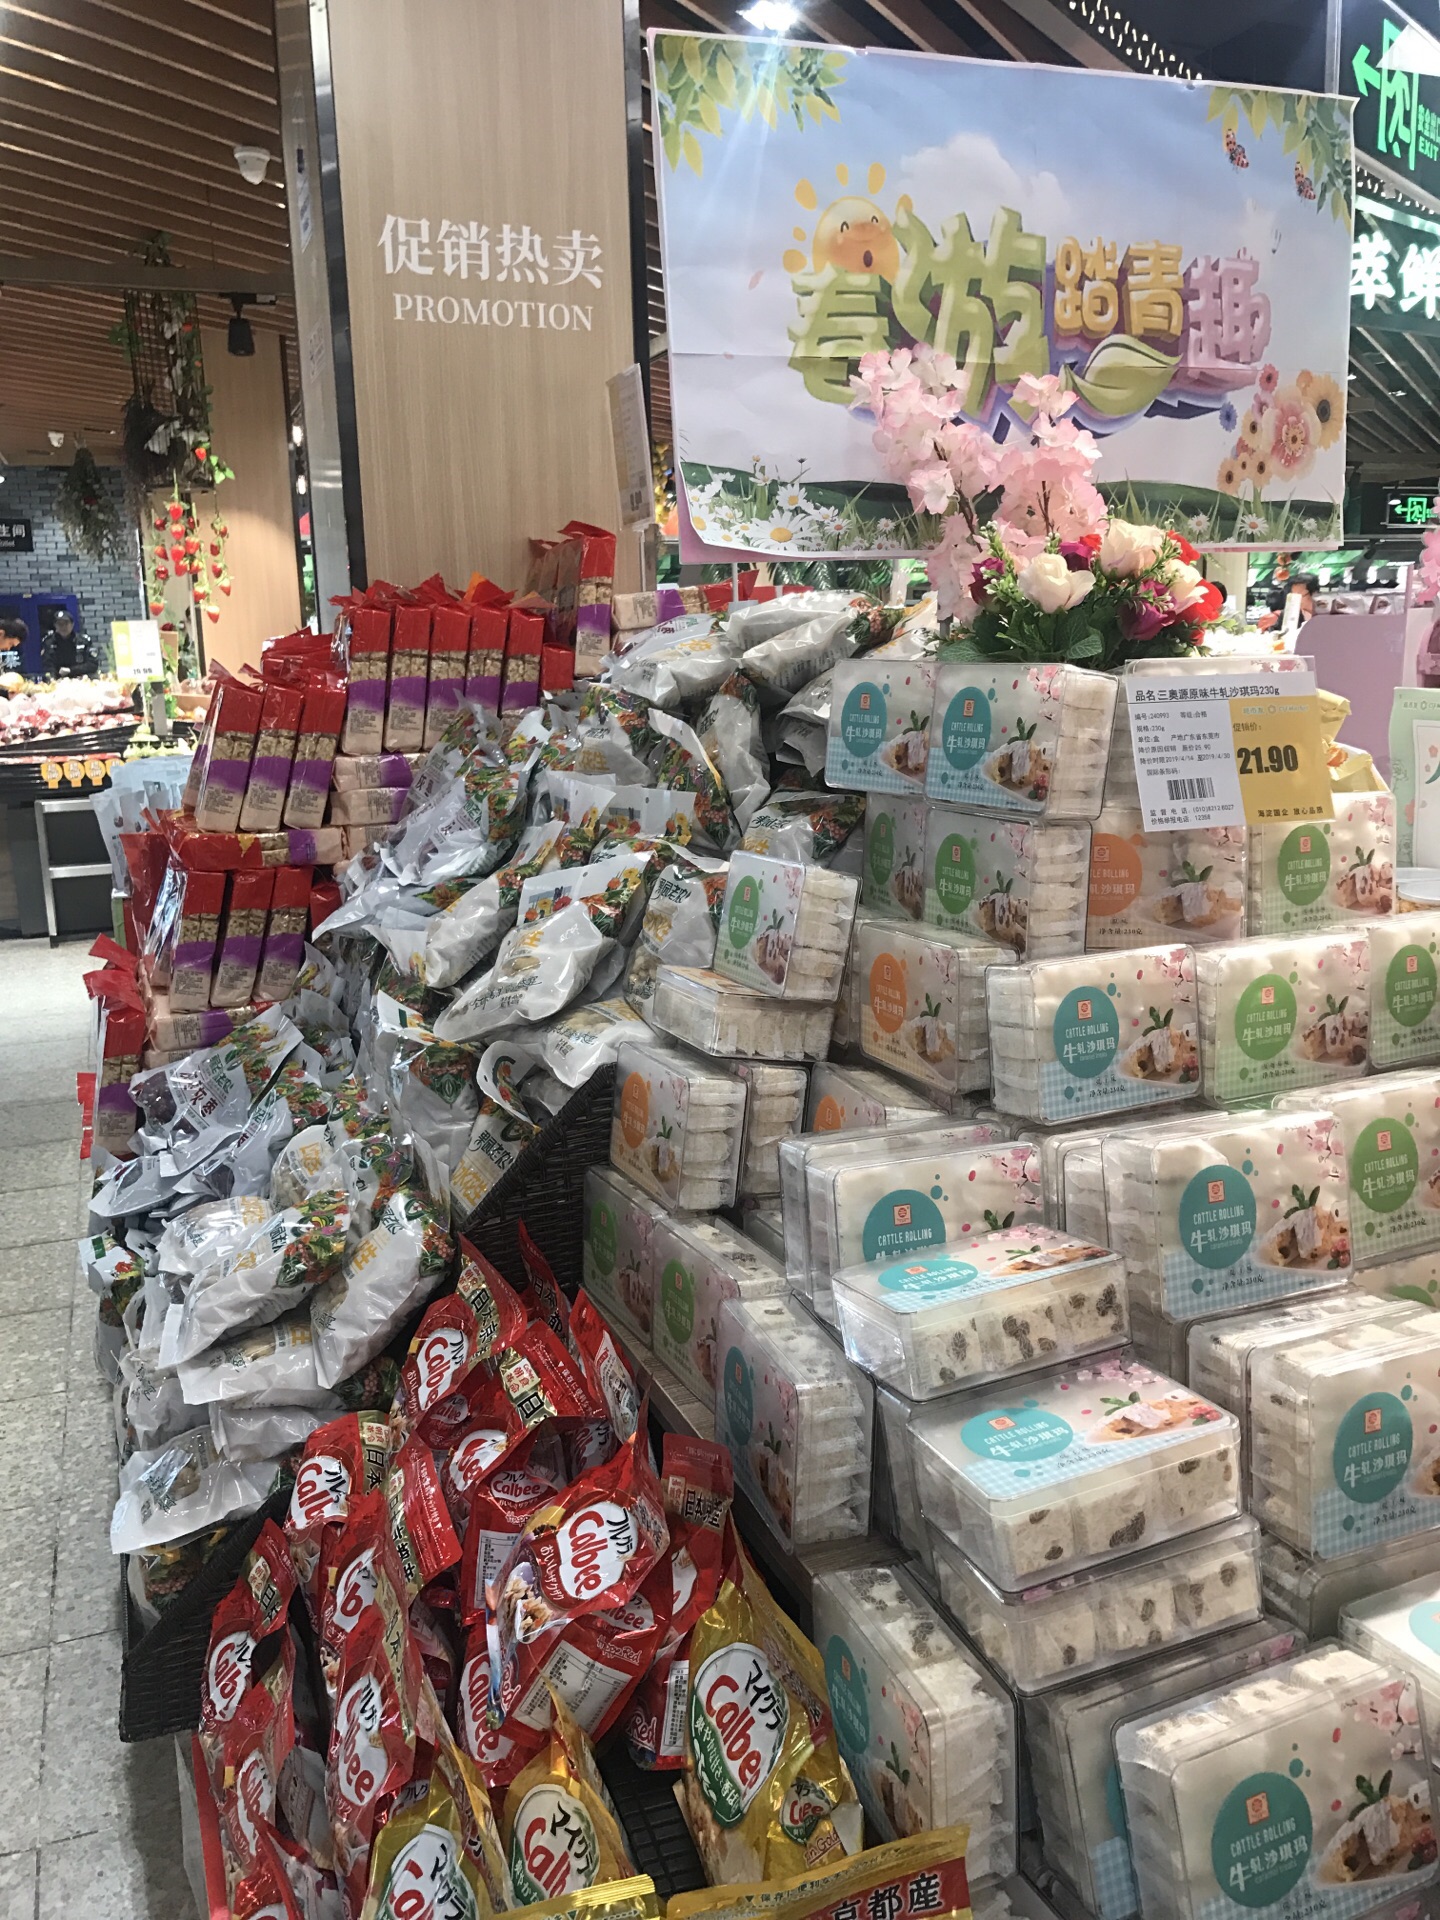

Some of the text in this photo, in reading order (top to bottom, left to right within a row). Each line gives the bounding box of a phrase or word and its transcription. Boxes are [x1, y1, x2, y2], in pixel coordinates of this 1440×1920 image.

[1419, 136, 1439, 161] EXIT
[377, 214, 604, 289] 促销热卖
[393, 292, 593, 331] PROMOTION
[1237, 744, 1299, 775] 21.90
[1065, 1022, 1109, 1039] CATTLE ROLLING
[1063, 1037, 1115, 1064] 牛轧沙琪玛
[1193, 1205, 1244, 1225] CATTLE ROLLING
[878, 1228, 932, 1246] CATTLE ROLLING
[1190, 1220, 1252, 1253] 牛轧沙琪玛
[984, 1421, 1049, 1445] CATTLE ROLLING
[1348, 1432, 1400, 1458] CATTLE ROLLING
[1344, 1449, 1407, 1488] 牛轧沙琪玛
[493, 1480, 541, 1498] Calbee
[607, 1507, 633, 1555] フルグラ
[568, 1510, 605, 1597] Calbee
[744, 1659, 784, 1731] マイグラ
[550, 1801, 594, 1875] マイグラ
[1230, 1817, 1296, 1858] CATTLE ROLLING
[1229, 1835, 1308, 1892] 牛轧沙琪玛
